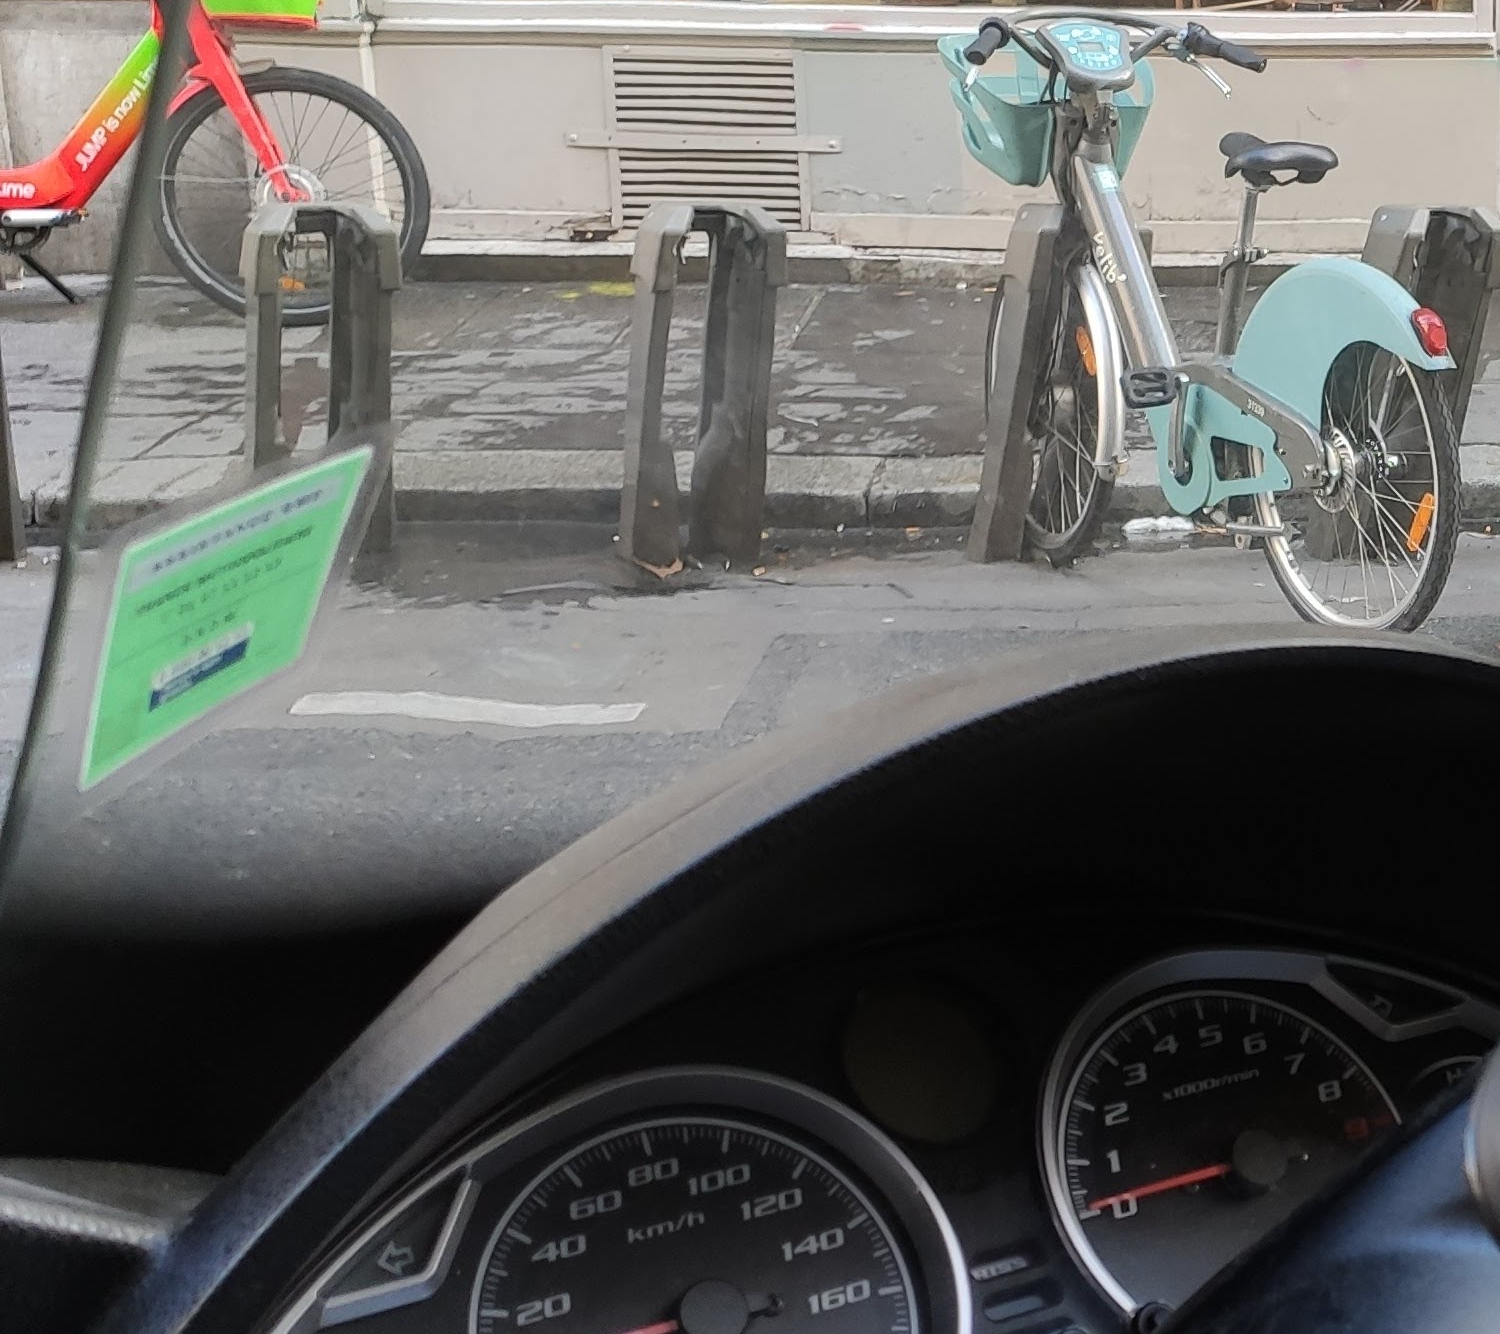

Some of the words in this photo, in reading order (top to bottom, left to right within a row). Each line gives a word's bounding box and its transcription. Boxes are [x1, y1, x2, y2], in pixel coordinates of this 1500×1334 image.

[1152, 1033, 1181, 1056] 4
[1198, 1023, 1224, 1048] 5
[1241, 1031, 1268, 1056] 6
[1122, 1061, 1149, 1087] 3
[1284, 1051, 1307, 1076] 7
[1317, 1078, 1343, 1103] 8
[1103, 1101, 1131, 1127] 2
[626, 1156, 681, 1189] 80
[1105, 1148, 1122, 1174] 1
[686, 1163, 752, 1198] 100
[568, 1189, 624, 1223] 60
[739, 1187, 805, 1223] 120
[1110, 1192, 1139, 1220] 0
[626, 1209, 706, 1244] km/h
[530, 1234, 588, 1266] 40
[780, 1227, 846, 1262] 140
[515, 1291, 573, 1328] 20
[806, 1278, 872, 1316] 160
